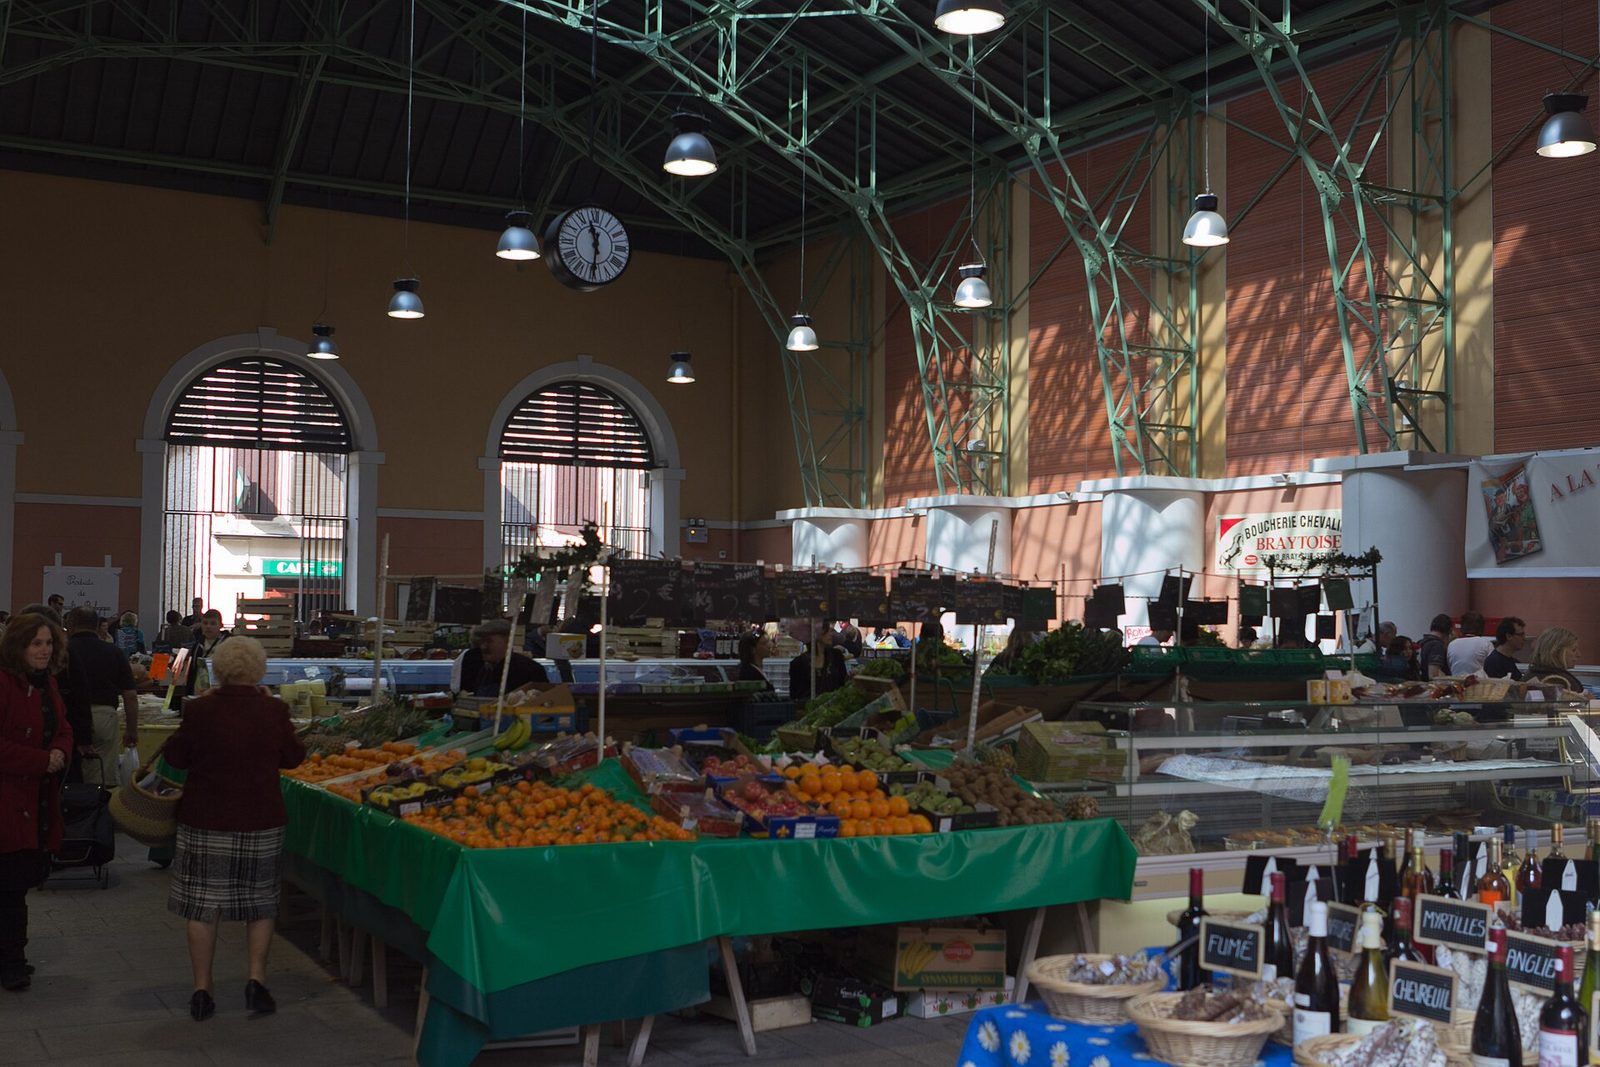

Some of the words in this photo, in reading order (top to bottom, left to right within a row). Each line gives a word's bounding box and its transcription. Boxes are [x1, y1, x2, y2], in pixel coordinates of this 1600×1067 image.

[1551, 483, 1564, 503] A
[1566, 469, 1594, 493] LA
[1245, 516, 1297, 540] BOUCHERIE
[1300, 515, 1342, 532] CHEVALI
[1256, 534, 1341, 551] BRAYTOISE
[1422, 910, 1487, 938] MYRTILLES
[1207, 932, 1254, 961] FUMÉ
[1393, 978, 1452, 1011] CHEVREUIL
